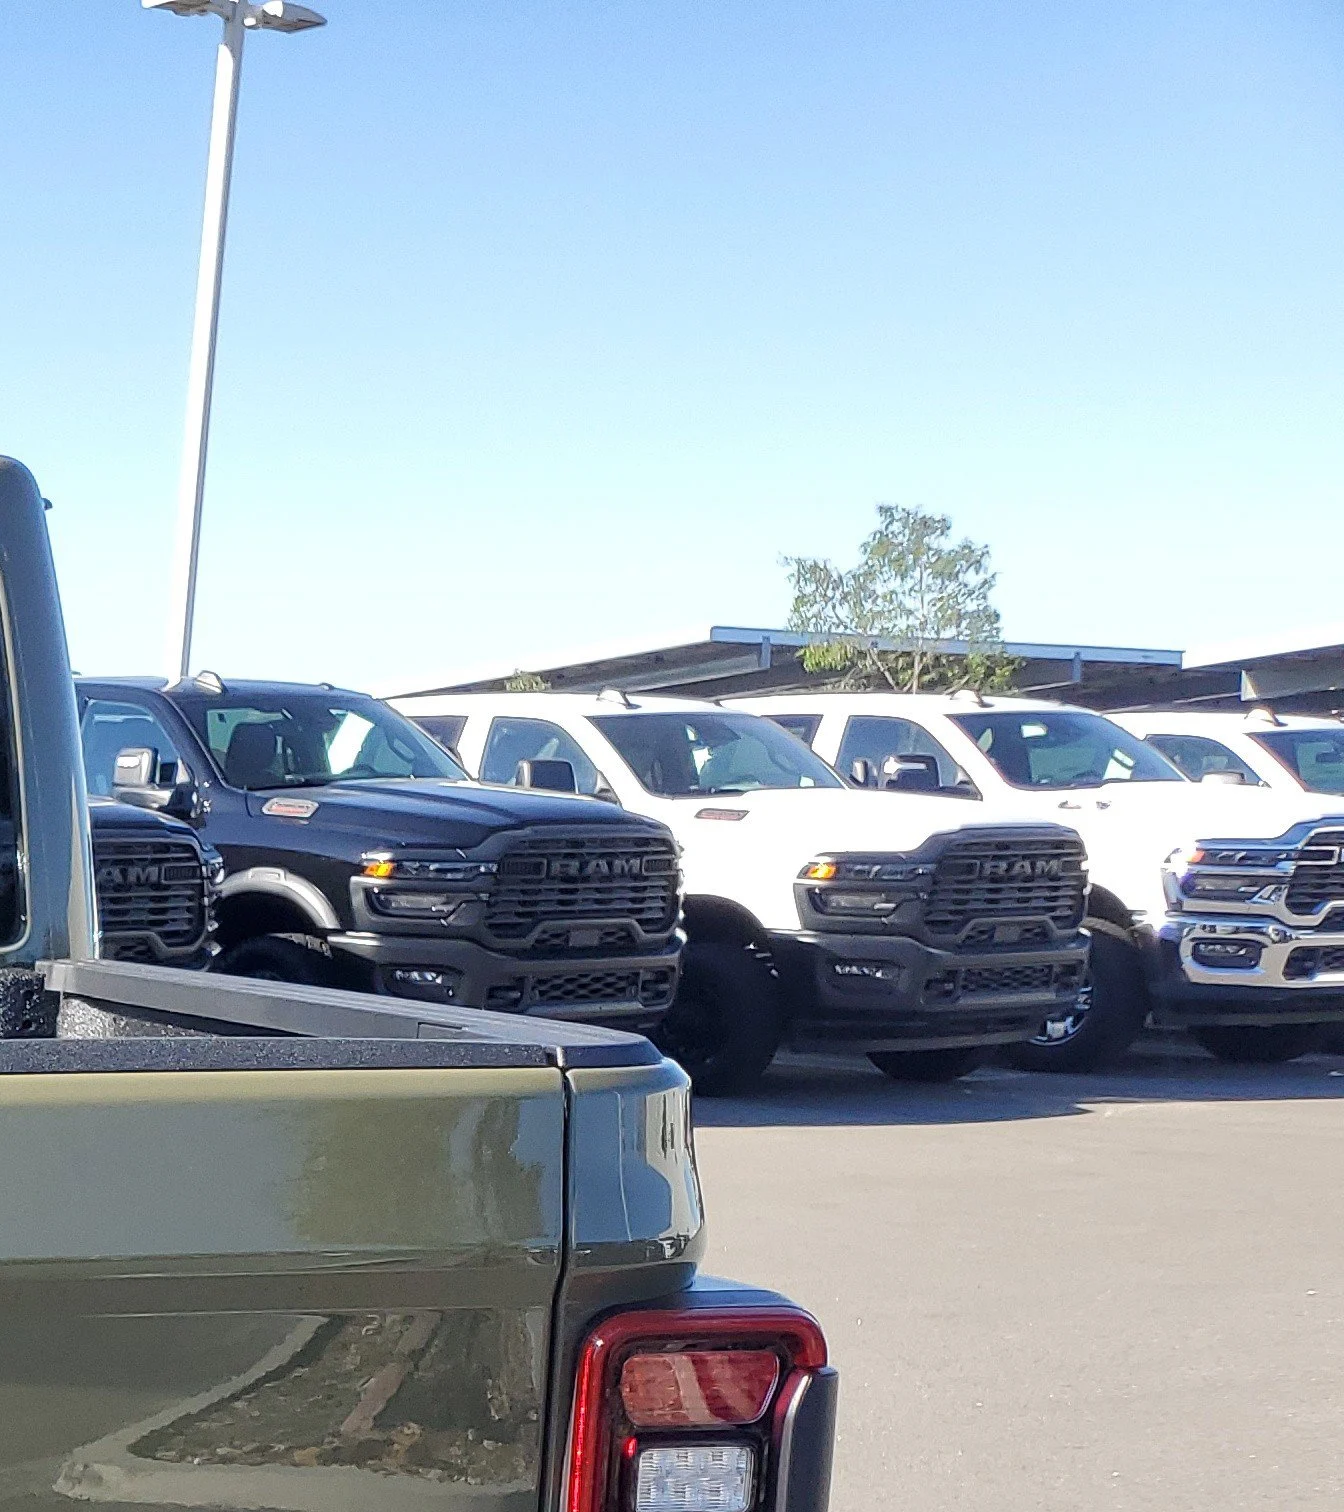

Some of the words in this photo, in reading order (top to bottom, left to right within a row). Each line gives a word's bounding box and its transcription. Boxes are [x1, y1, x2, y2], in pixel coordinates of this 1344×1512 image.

[96, 866, 159, 883] AM
[550, 857, 642, 878] RAM
[983, 858, 1061, 876] RAM
